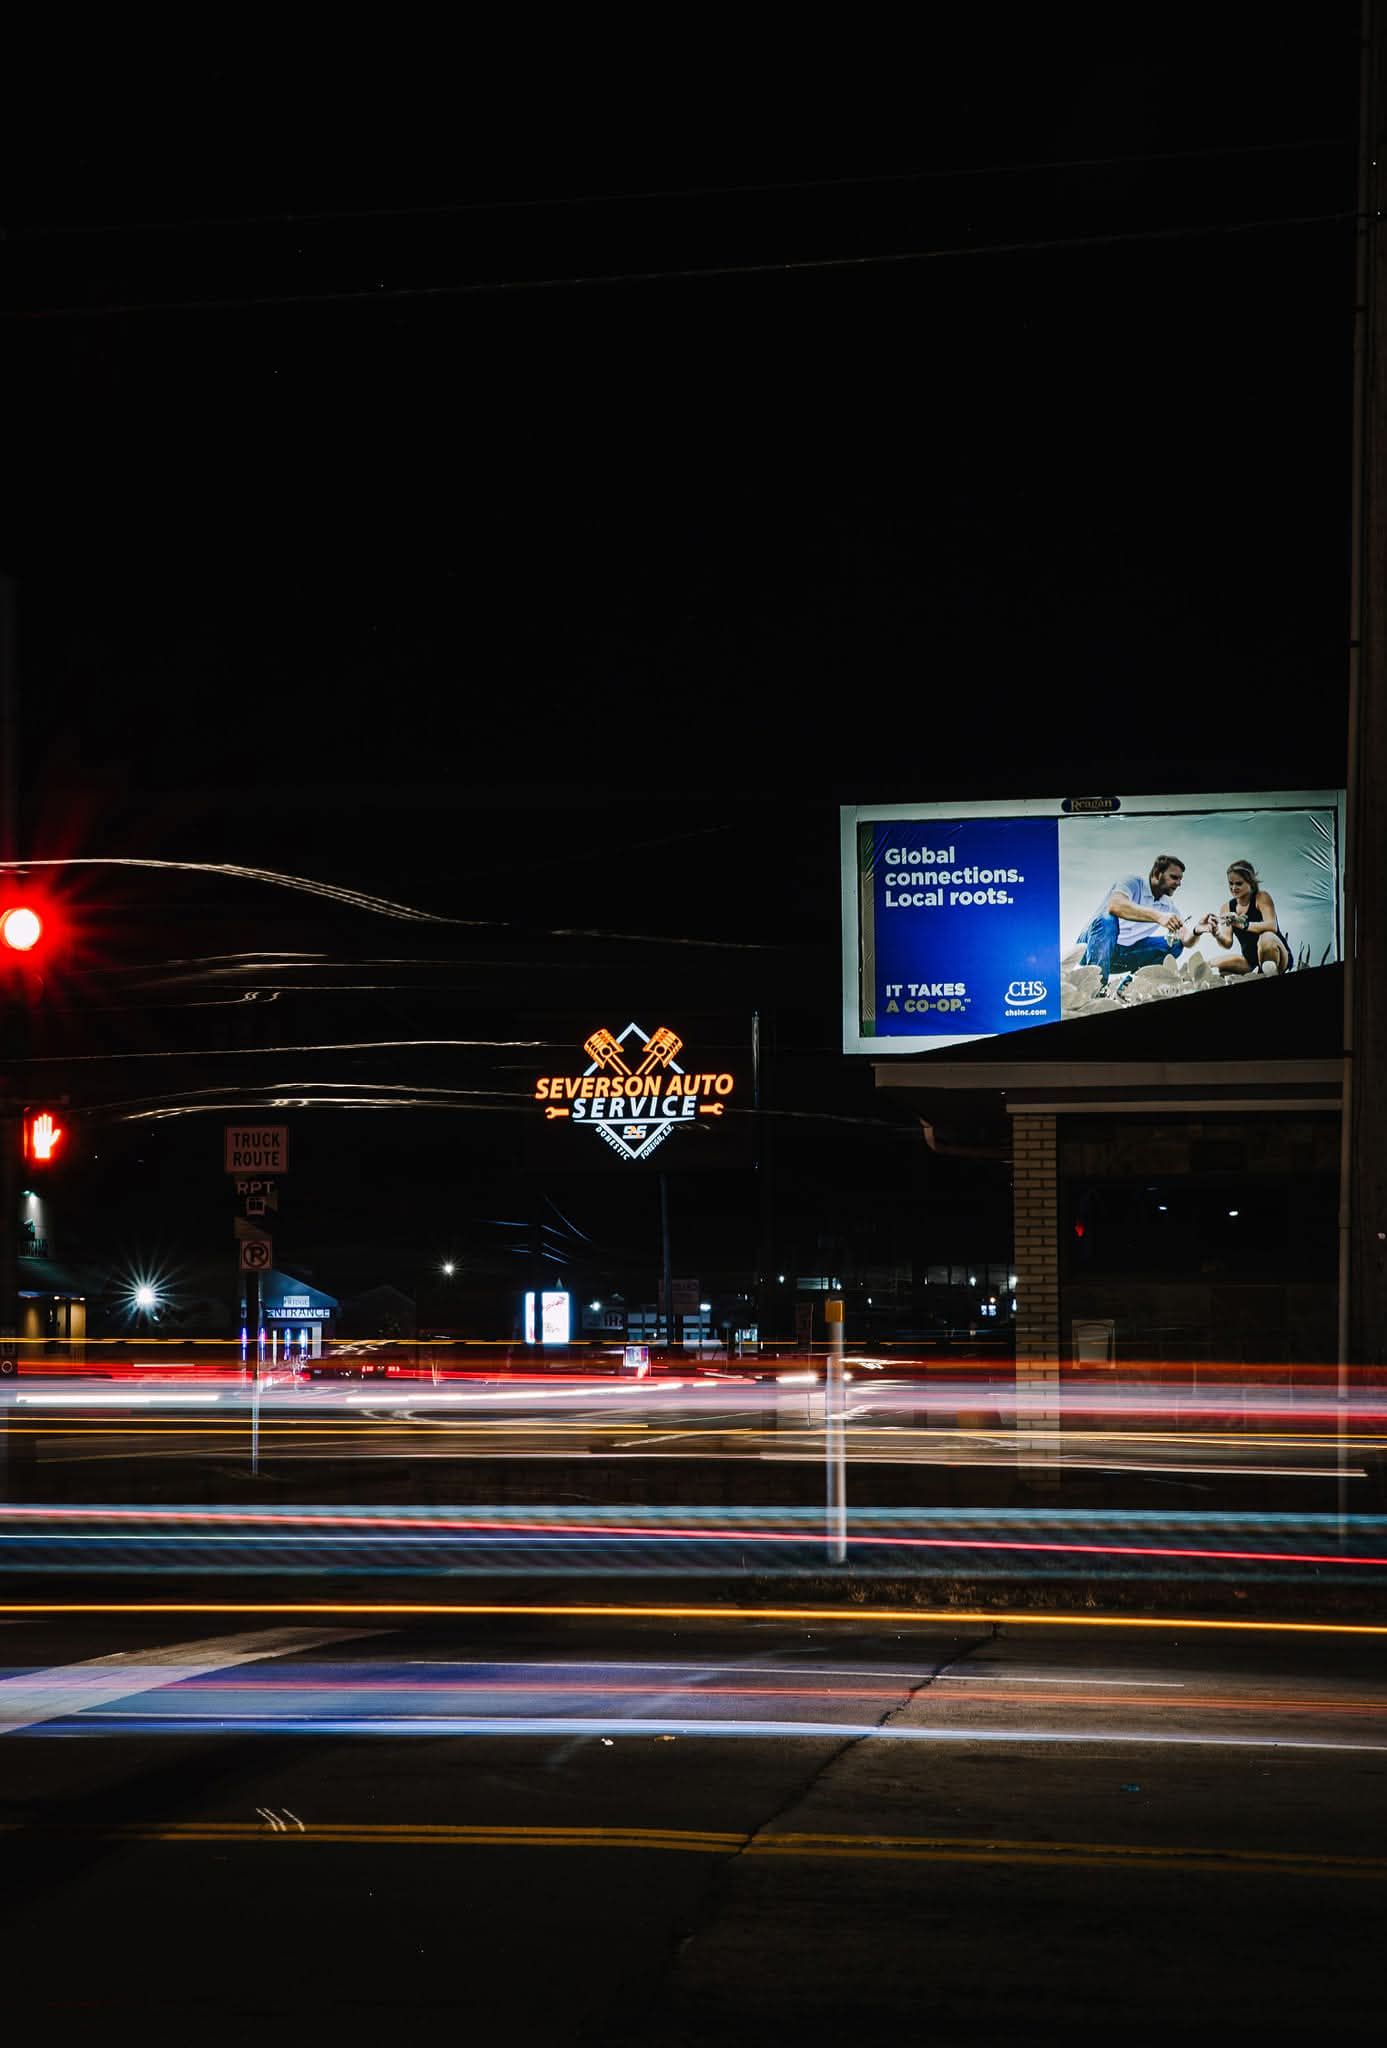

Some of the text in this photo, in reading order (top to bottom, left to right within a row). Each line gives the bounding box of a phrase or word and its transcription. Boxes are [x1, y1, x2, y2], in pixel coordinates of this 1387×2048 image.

[885, 847, 955, 865] Global
[885, 867, 1025, 886] connections.
[885, 888, 1013, 907] Local roots.
[886, 983, 965, 996] IT TAKES
[1009, 981, 1044, 996] CHS
[886, 999, 899, 1012] A
[1005, 1008, 1047, 1016] chsinc.com
[535, 1074, 733, 1098] SEVERSON AUTO
[572, 1096, 696, 1118] SERVICE
[233, 1133, 280, 1148] TRUCK
[595, 1126, 630, 1160] DOMESTIC
[233, 1151, 279, 1166] ROUTE
